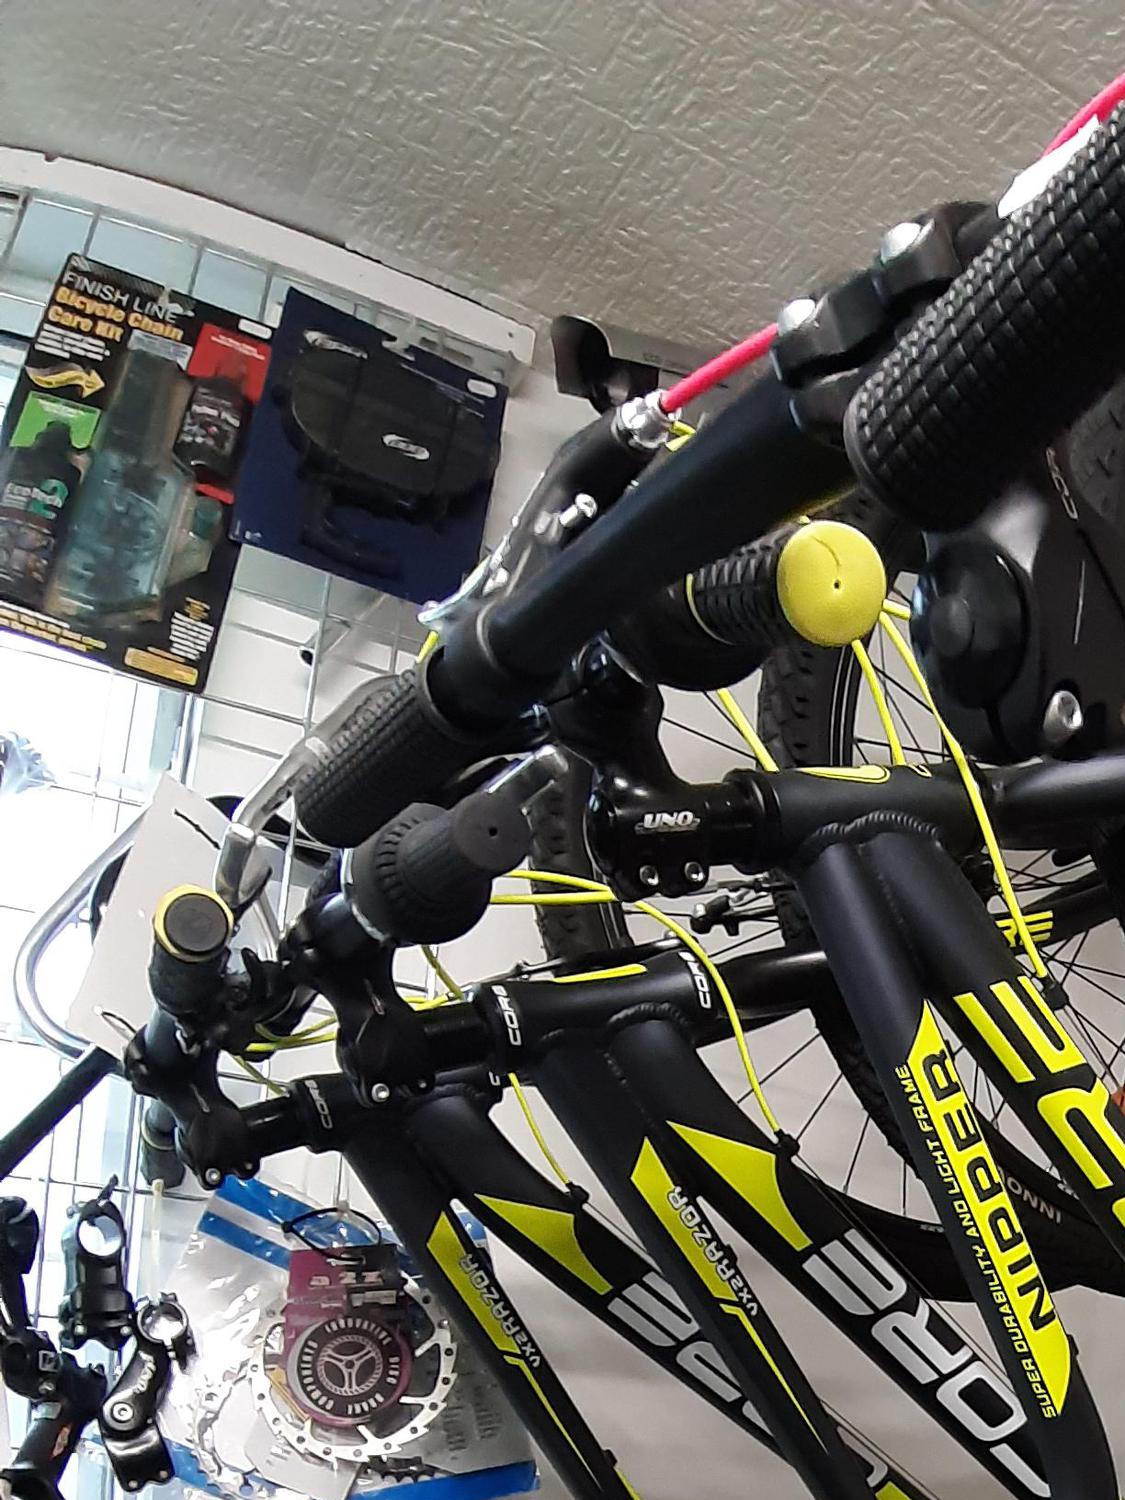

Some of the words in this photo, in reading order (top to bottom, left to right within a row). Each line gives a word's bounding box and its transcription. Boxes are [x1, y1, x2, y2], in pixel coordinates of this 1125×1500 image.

[56, 286, 126, 322] Bicycle
[128, 312, 184, 341] Chain
[62, 271, 130, 307] FINISH
[48, 305, 93, 332] Care
[635, 811, 701, 832] UNO
[895, 1064, 934, 1133] FRAME
[922, 1045, 1056, 1331] NIPPER
[926, 1138, 960, 1195] LIGHT
[953, 1199, 979, 1237] AND
[973, 1245, 1029, 1354] DURABILITY
[1021, 1358, 1056, 1418] SUPER
